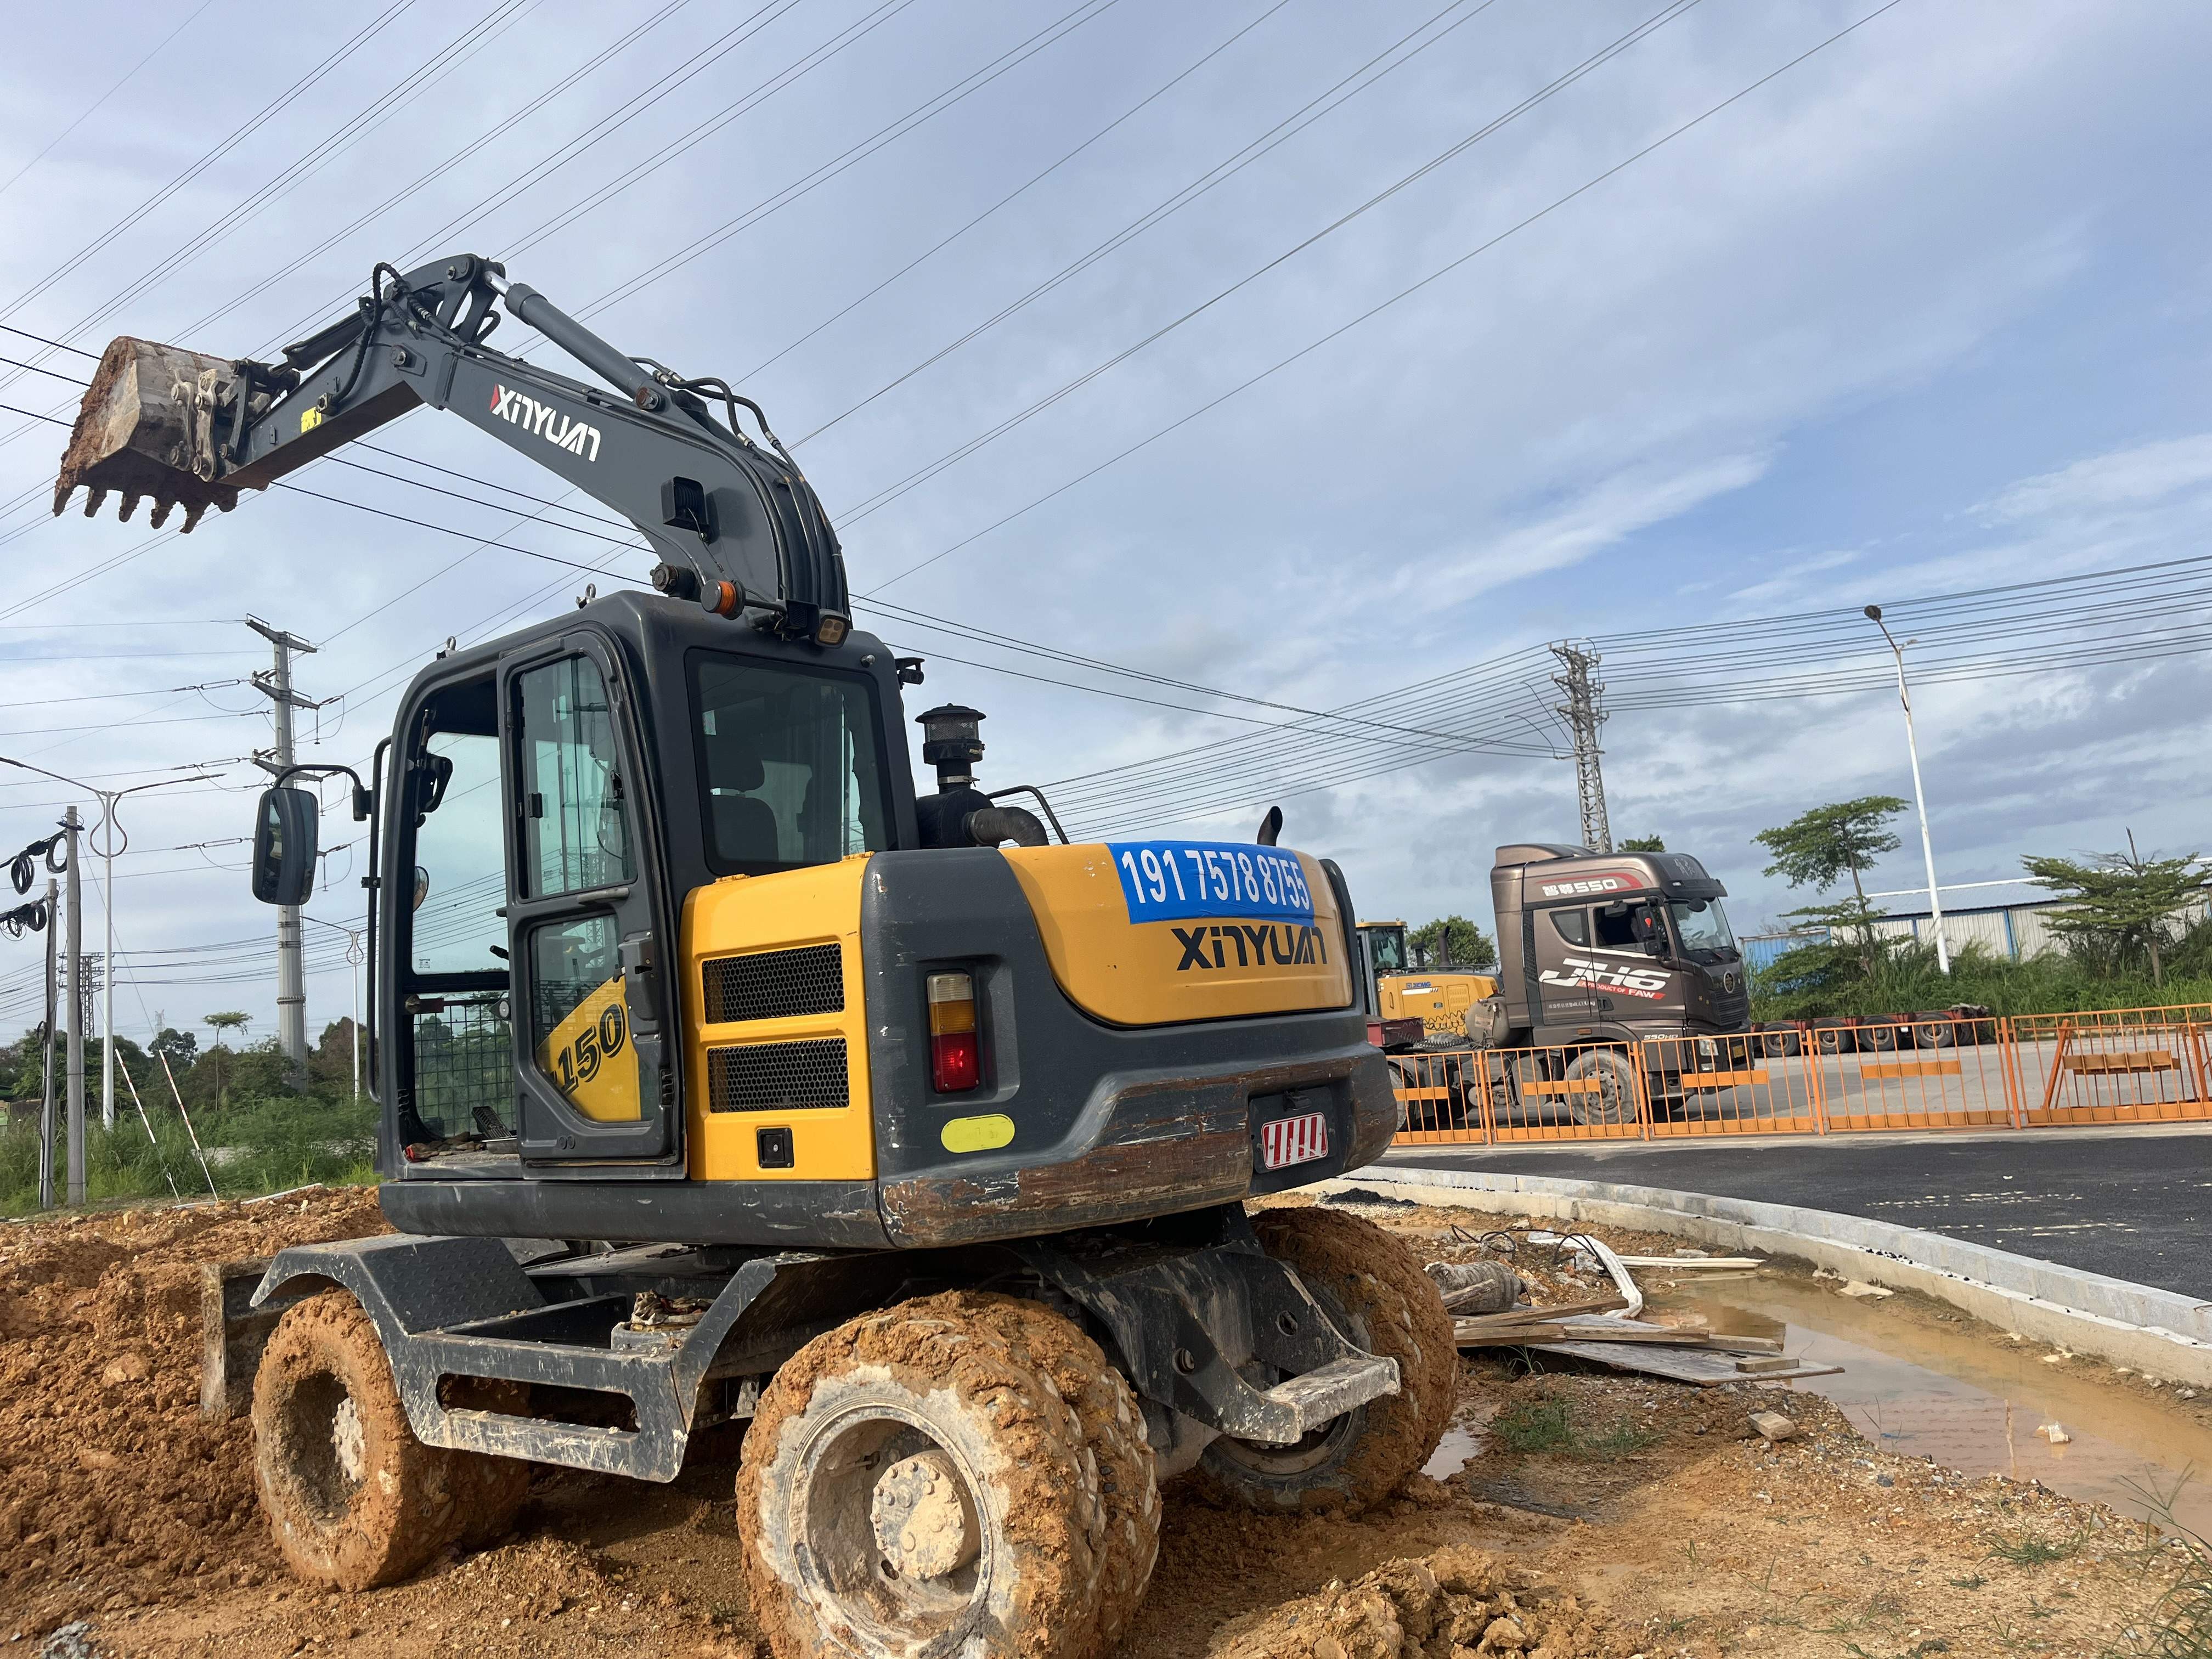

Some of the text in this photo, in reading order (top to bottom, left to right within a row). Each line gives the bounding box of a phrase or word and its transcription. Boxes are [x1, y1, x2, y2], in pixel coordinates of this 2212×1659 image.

[1121, 849, 1310, 910] 191 7578 8755
[1628, 989, 1655, 998] FAW
